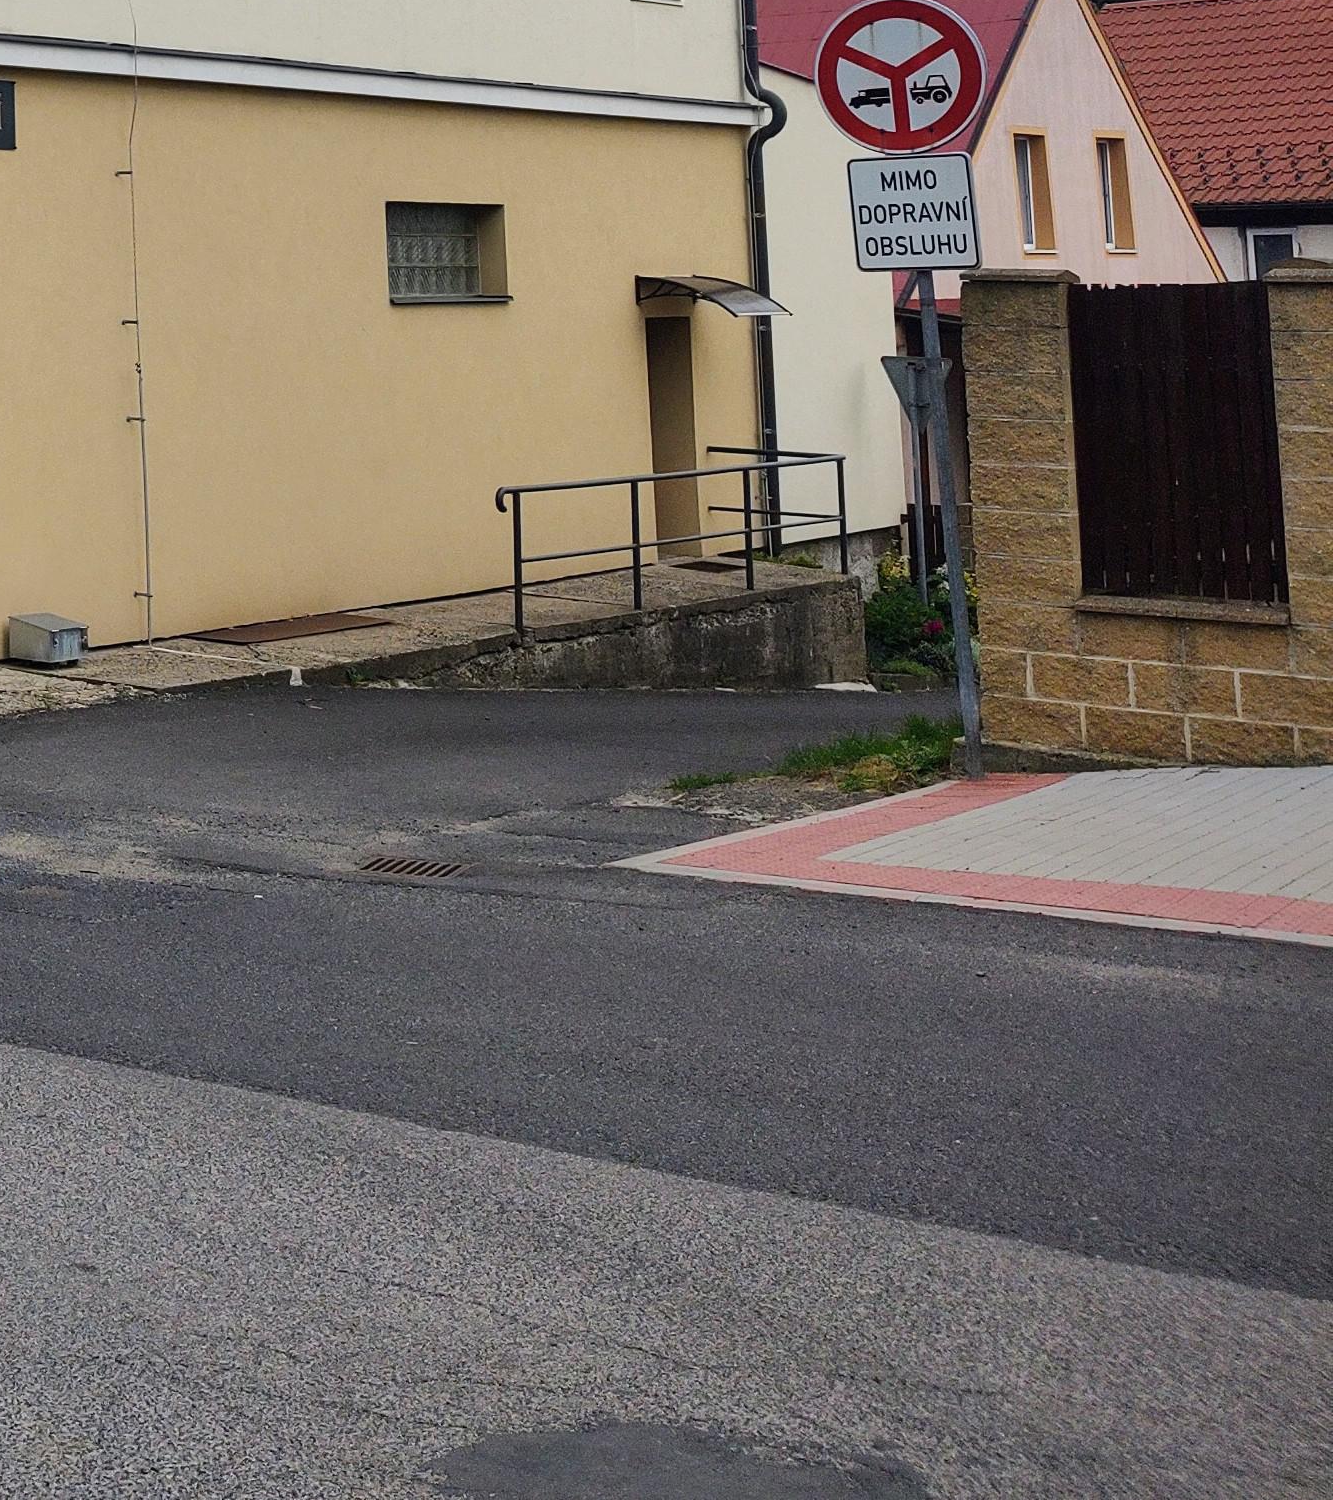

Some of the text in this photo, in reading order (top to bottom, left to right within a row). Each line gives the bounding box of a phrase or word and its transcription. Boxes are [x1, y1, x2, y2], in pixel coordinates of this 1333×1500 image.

[880, 169, 937, 192] MIMO
[858, 195, 968, 225] DOPRAVNÍ
[865, 233, 968, 257] OBSLUHU
